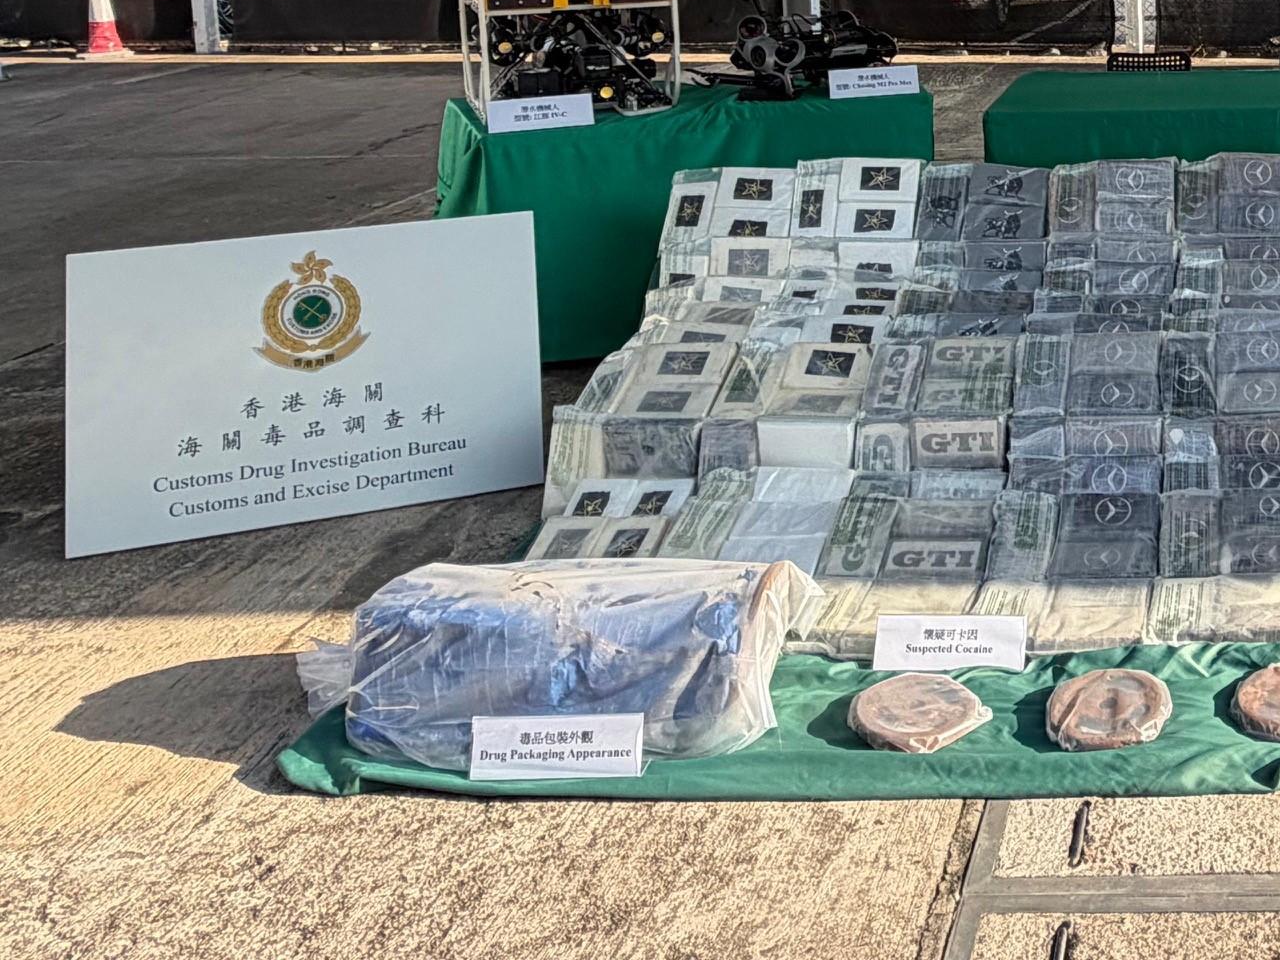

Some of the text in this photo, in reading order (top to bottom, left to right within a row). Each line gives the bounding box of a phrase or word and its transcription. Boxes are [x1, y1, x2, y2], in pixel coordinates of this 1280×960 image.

[935, 345, 1006, 364] GTI
[240, 381, 384, 420] 香港海關
[176, 402, 446, 459] 海關毒品調查科
[921, 432, 995, 454] GTI
[153, 437, 467, 494] Customs Drug Investigation Bureau
[169, 463, 455, 518] Customs and Excise Department
[892, 550, 976, 568] GTI
[923, 628, 978, 641] 懷疑可卡因
[905, 643, 993, 655] Suspected Cocaine
[519, 730, 594, 746] 毒品包裝外觀
[480, 748, 632, 762] Drug Packaging Appearance
